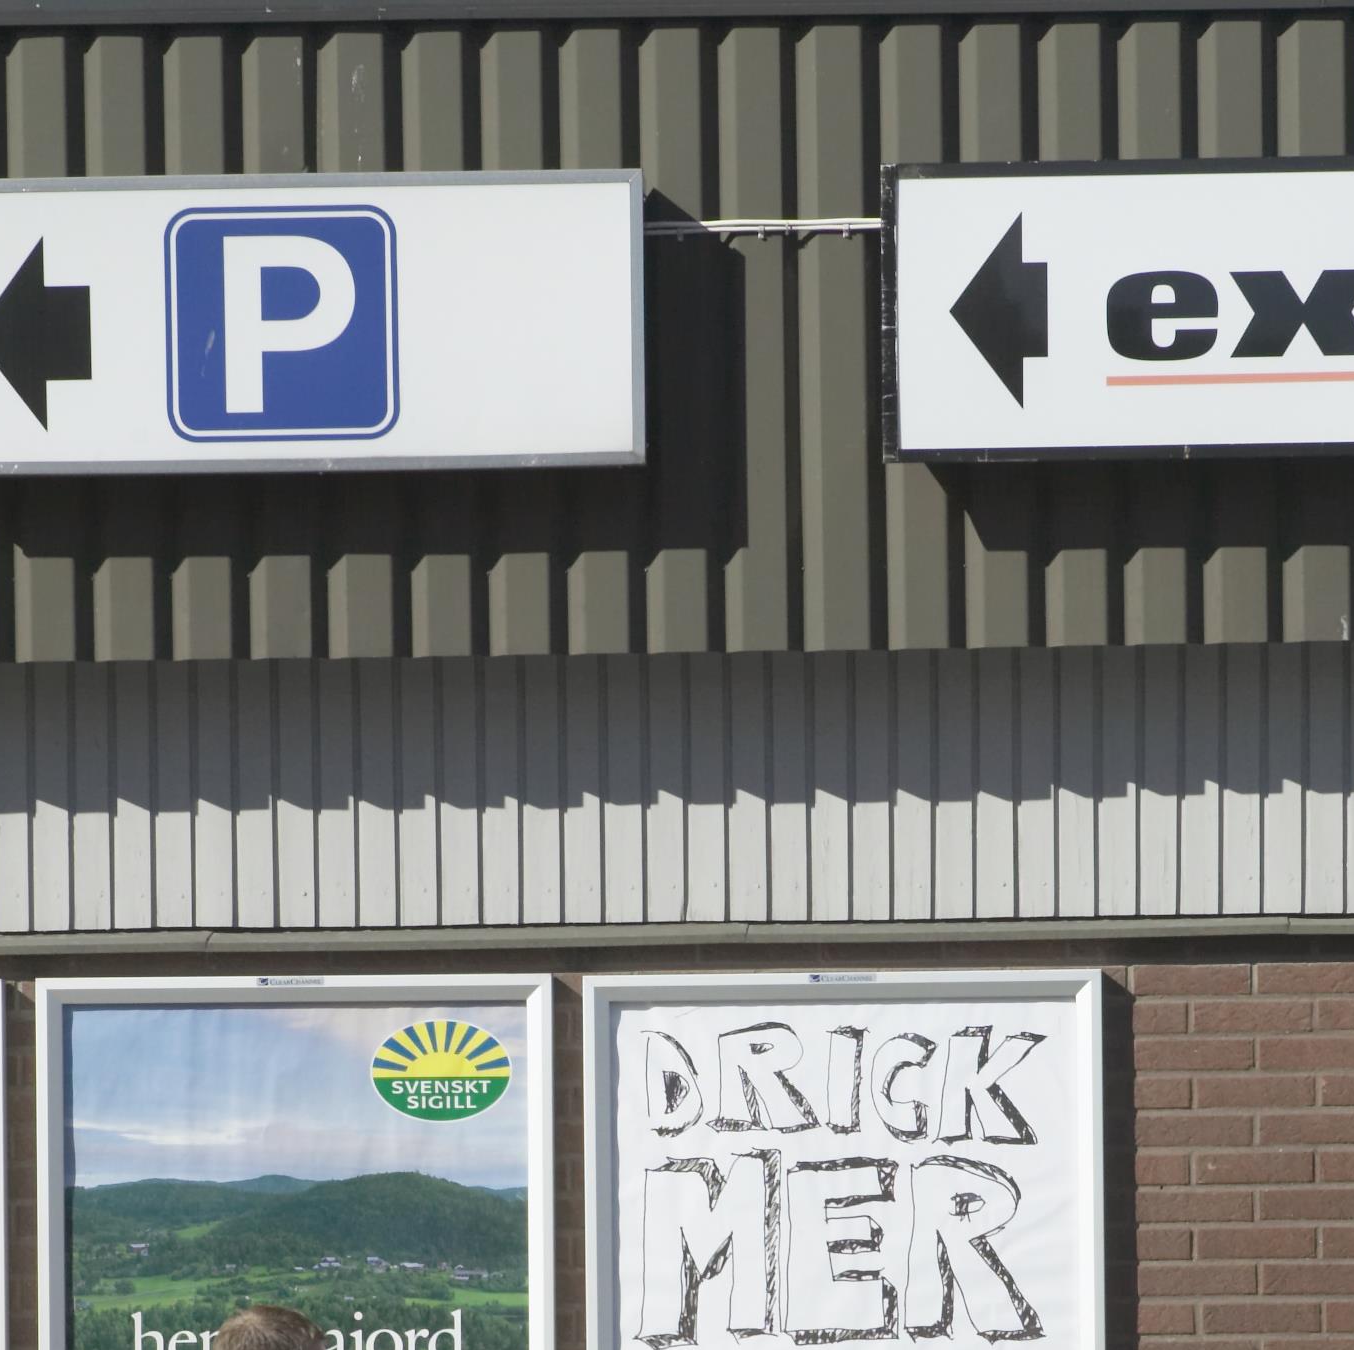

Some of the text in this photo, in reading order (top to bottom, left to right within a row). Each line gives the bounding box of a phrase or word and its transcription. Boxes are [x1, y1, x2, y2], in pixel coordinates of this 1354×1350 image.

[223, 236, 356, 413] P
[391, 1080, 491, 1094] SVENSKT
[407, 1095, 477, 1109] SIGILL
[641, 1022, 1047, 1144] DRICK
[634, 1148, 1046, 1350] MER
